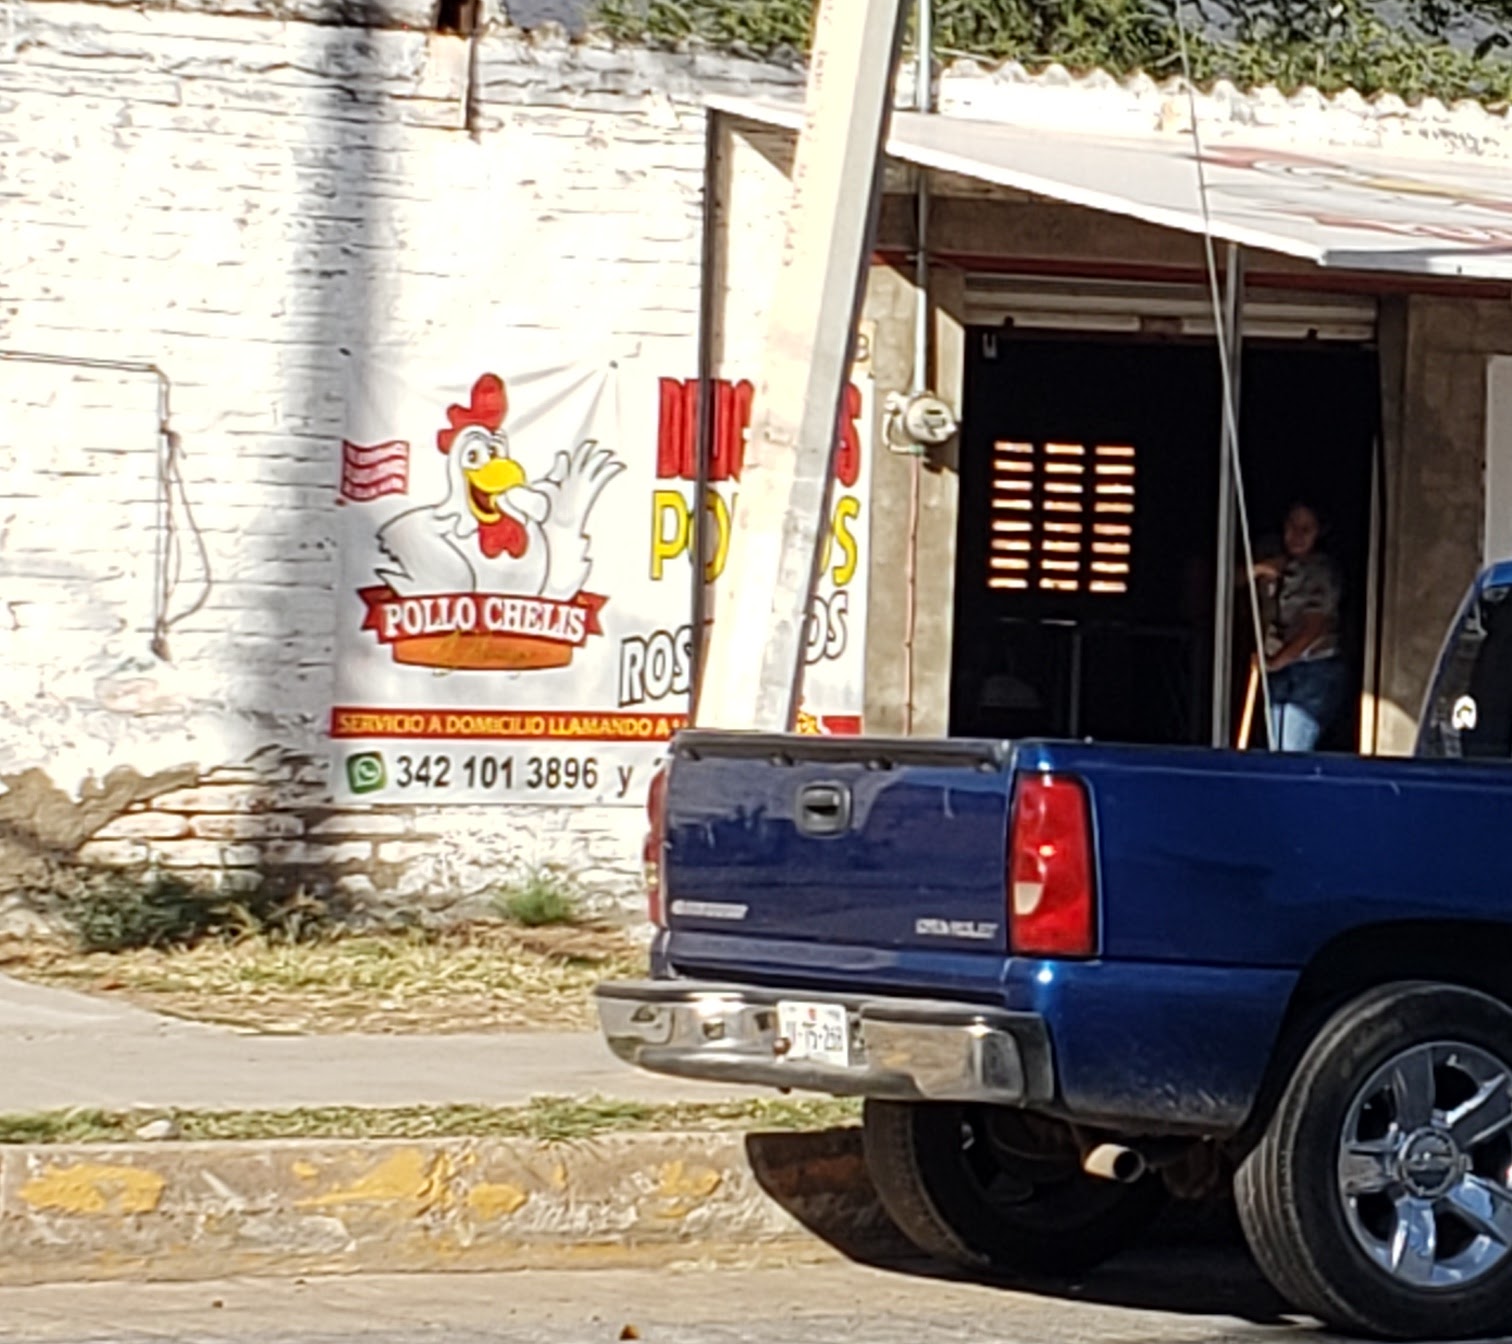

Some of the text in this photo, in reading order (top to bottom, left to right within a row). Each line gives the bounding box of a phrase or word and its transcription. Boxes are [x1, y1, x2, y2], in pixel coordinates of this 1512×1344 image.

[384, 596, 586, 643] POLLO CHELIS
[338, 713, 423, 734] SERVICIO
[427, 715, 442, 734] A
[445, 715, 545, 736] DOMICILIO
[548, 715, 653, 737] LLAMANDO
[655, 717, 670, 737] A
[396, 755, 451, 788] 342
[463, 755, 514, 790] 101
[526, 755, 599, 790] 3896
[616, 764, 633, 798] y
